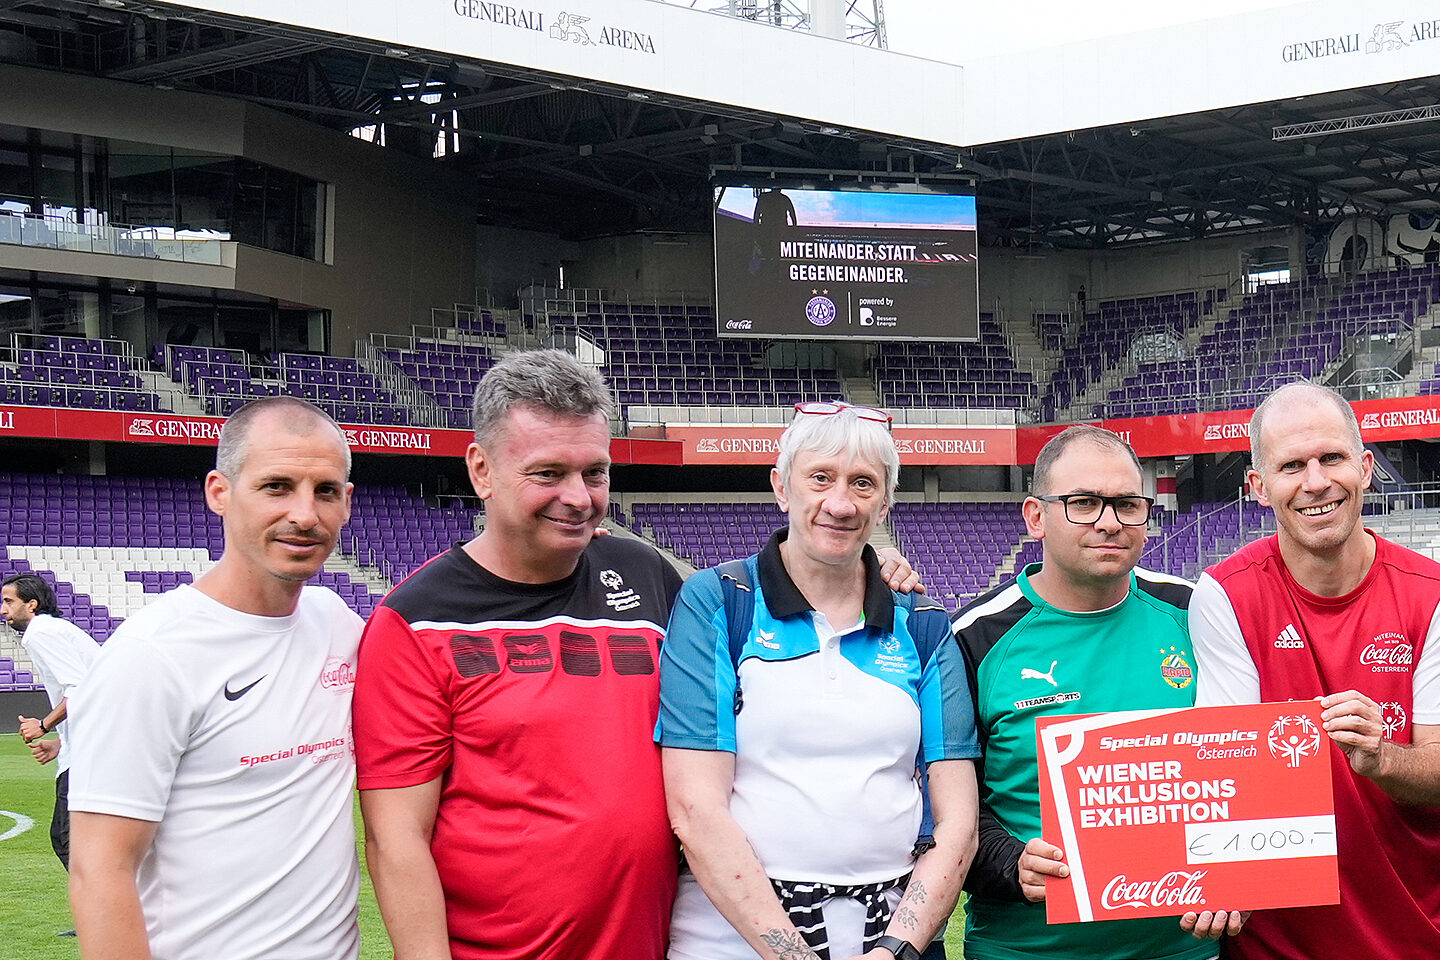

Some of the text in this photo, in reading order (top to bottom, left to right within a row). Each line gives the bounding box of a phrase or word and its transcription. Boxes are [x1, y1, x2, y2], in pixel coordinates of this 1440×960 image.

[453, 0, 657, 54] GENERALI ARENA
[1282, 33, 1361, 63] GENERALI
[780, 241, 916, 261] MITEINANDER STATT
[789, 264, 909, 283] GEGENEINANDER.
[859, 297, 894, 307] powered by
[726, 319, 752, 330] Coca-Cola
[155, 420, 221, 438] GENERA
[359, 430, 431, 449] GENERALI
[720, 438, 780, 453] GENERA
[914, 439, 986, 453] GENERALI
[1274, 639, 1304, 648] adidas
[1360, 643, 1413, 664] Coca-Cola
[1100, 730, 1258, 751] Special Olympics
[240, 737, 345, 767] Special Olympics
[1196, 745, 1257, 760] Österreich
[1077, 760, 1182, 785] WIENER
[1079, 778, 1236, 806] INKLUSIONS
[1080, 801, 1230, 828] EXHIBITION
[1101, 869, 1208, 910] Coca-Cola
